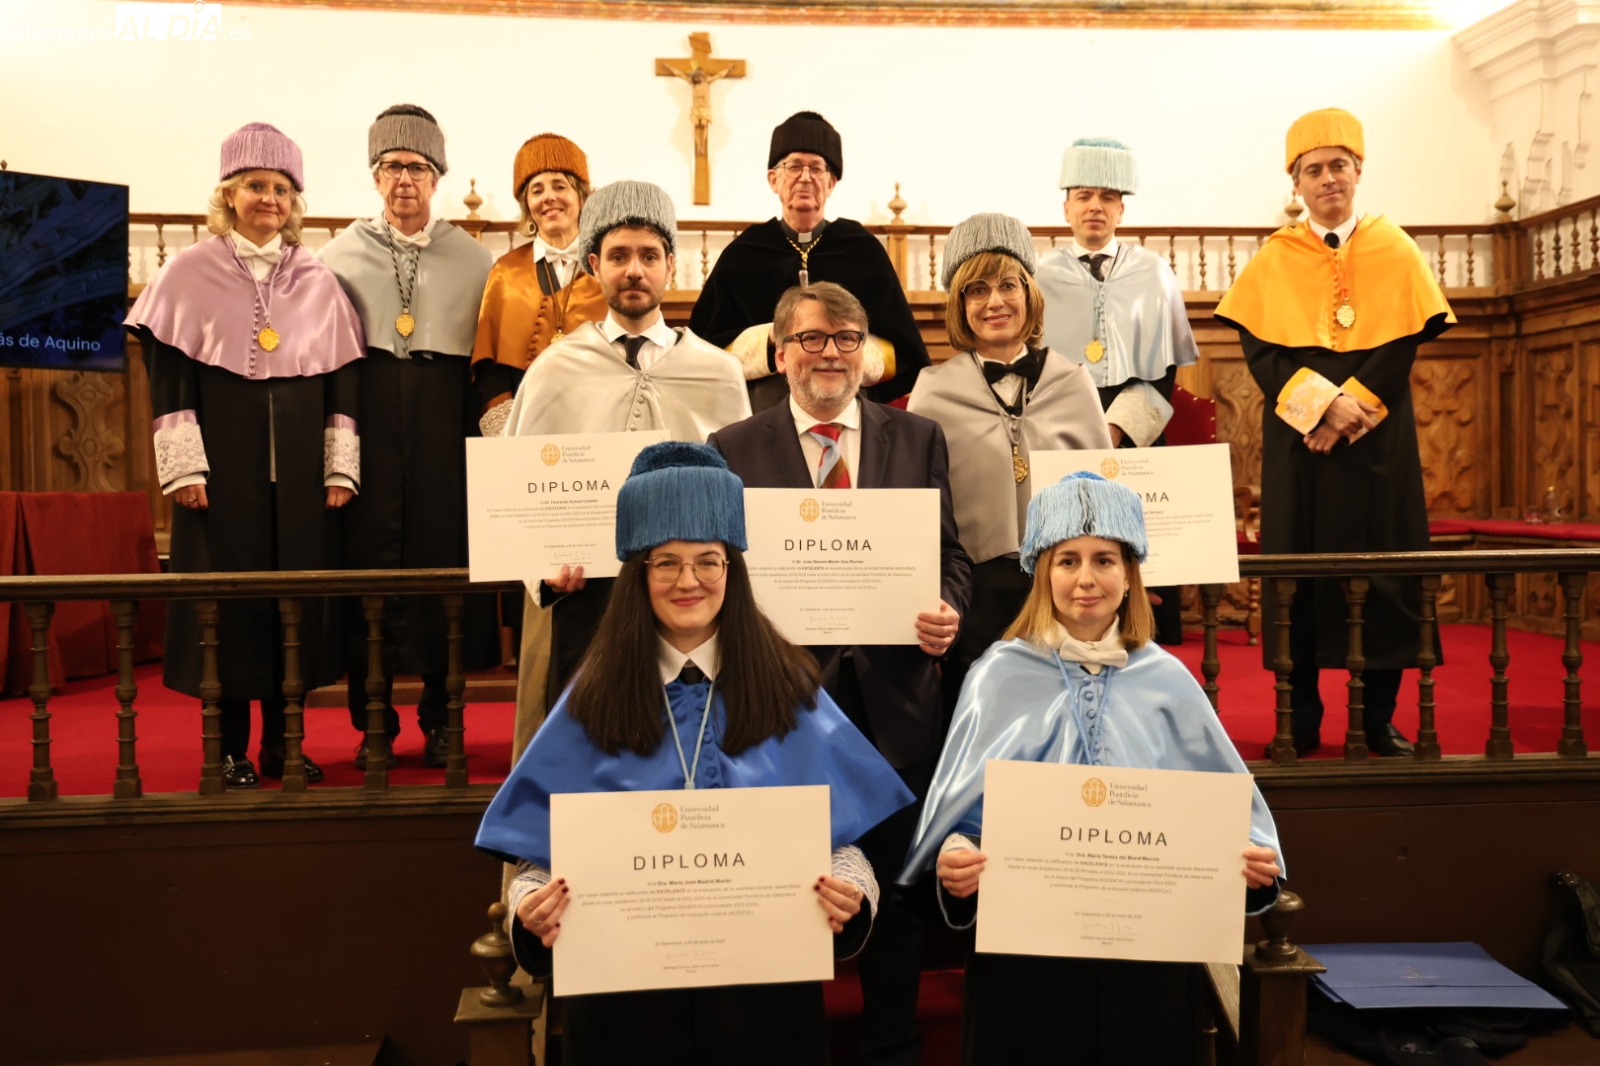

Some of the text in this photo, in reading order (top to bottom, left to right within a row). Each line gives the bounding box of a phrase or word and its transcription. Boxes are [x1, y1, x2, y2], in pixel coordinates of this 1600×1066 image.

[18, 333, 40, 348] de
[44, 335, 101, 352] Aquino
[528, 479, 610, 494] DIPLOMA
[784, 539, 872, 551] DIPLOMA
[1110, 782, 1148, 791] Universidad
[1109, 790, 1139, 799] Pontificia
[1117, 799, 1152, 808] Salamanca
[680, 804, 719, 813] Universidad
[680, 813, 711, 821] Pontificia
[680, 822, 688, 830] de
[1060, 826, 1167, 846] DIPLOMA
[633, 852, 745, 871] DIPLOMA
